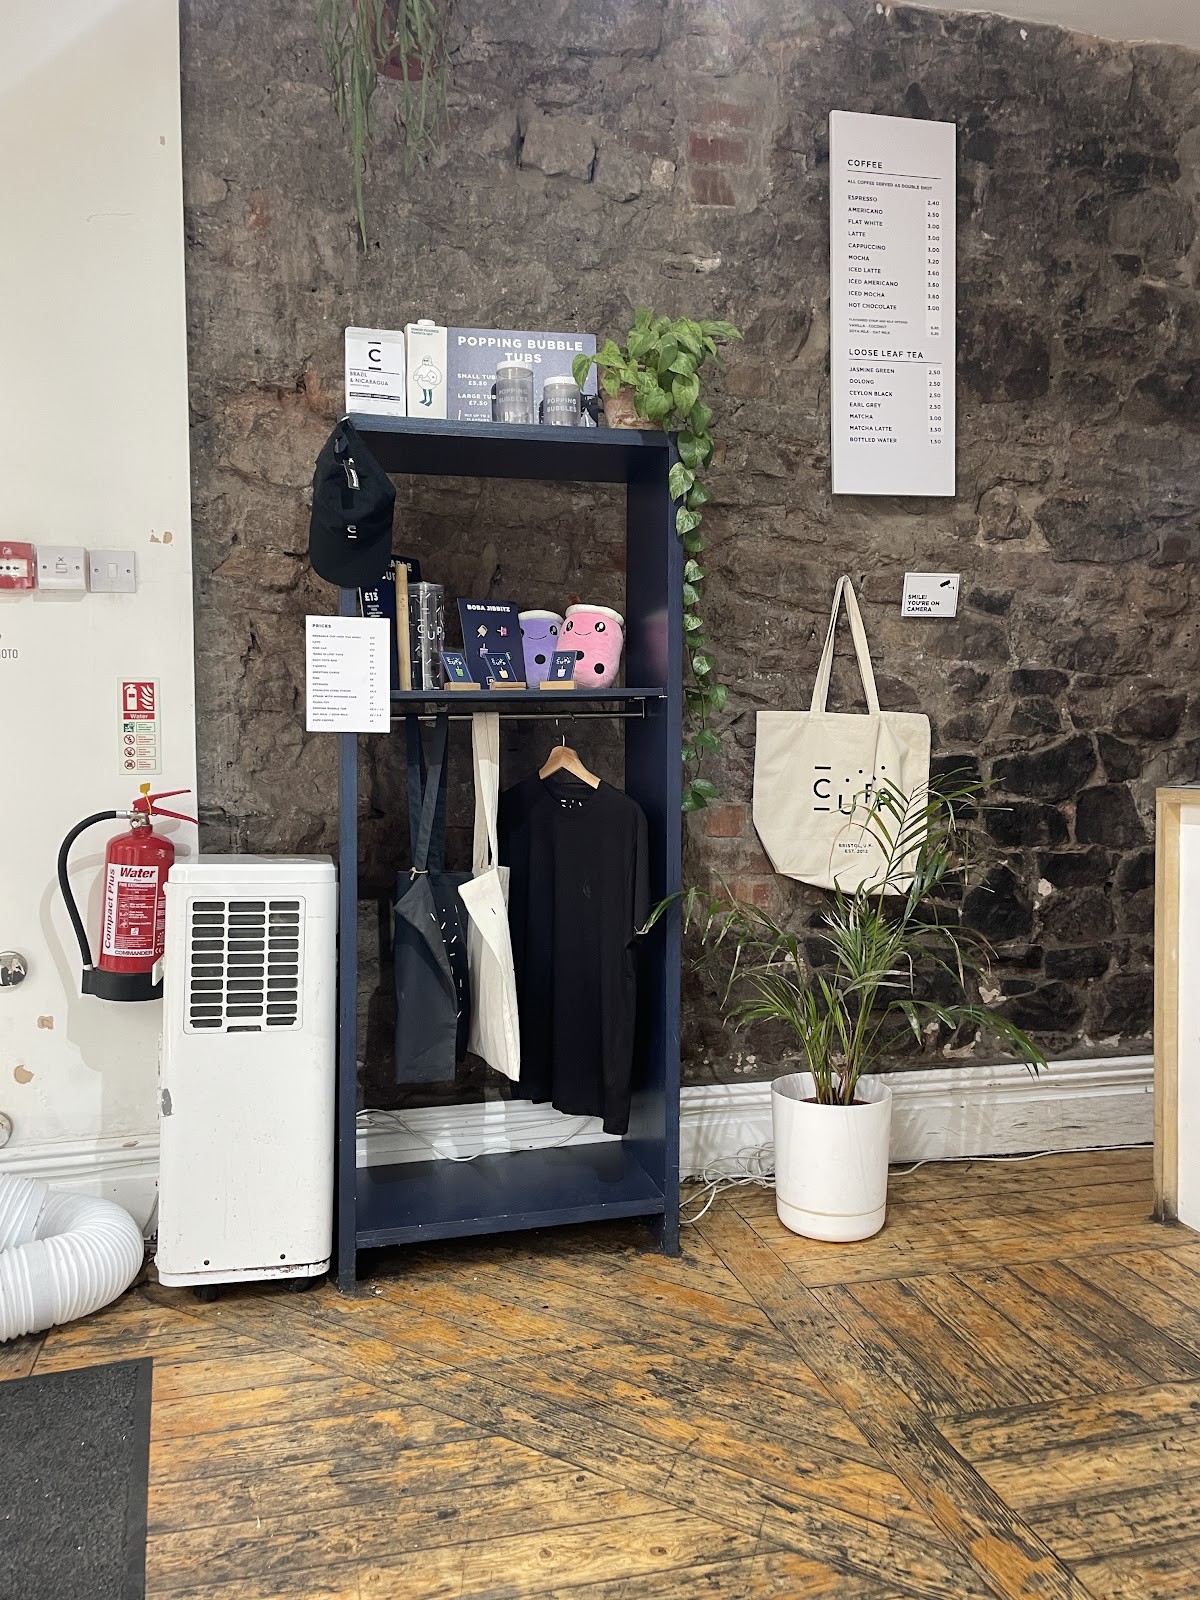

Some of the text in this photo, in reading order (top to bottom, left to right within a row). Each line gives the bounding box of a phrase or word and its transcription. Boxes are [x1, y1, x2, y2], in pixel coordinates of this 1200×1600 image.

[847, 159, 883, 169] COFFEE
[848, 207, 884, 215] AMERICANO
[848, 243, 886, 251] CAPPUCCINO
[458, 336, 583, 351] POPPING BUBBLE
[369, 349, 381, 362] C
[505, 352, 542, 363] TUBS
[849, 348, 924, 359] LOOSE LEAF TEA
[355, 378, 389, 386] NICARAGUA
[498, 387, 528, 395] POPPING
[547, 405, 576, 413] BUBBLES
[364, 592, 378, 601] £13
[0, 649, 18, 659] OTO
[120, 867, 155, 878] Water
[105, 897, 114, 948] Compact
